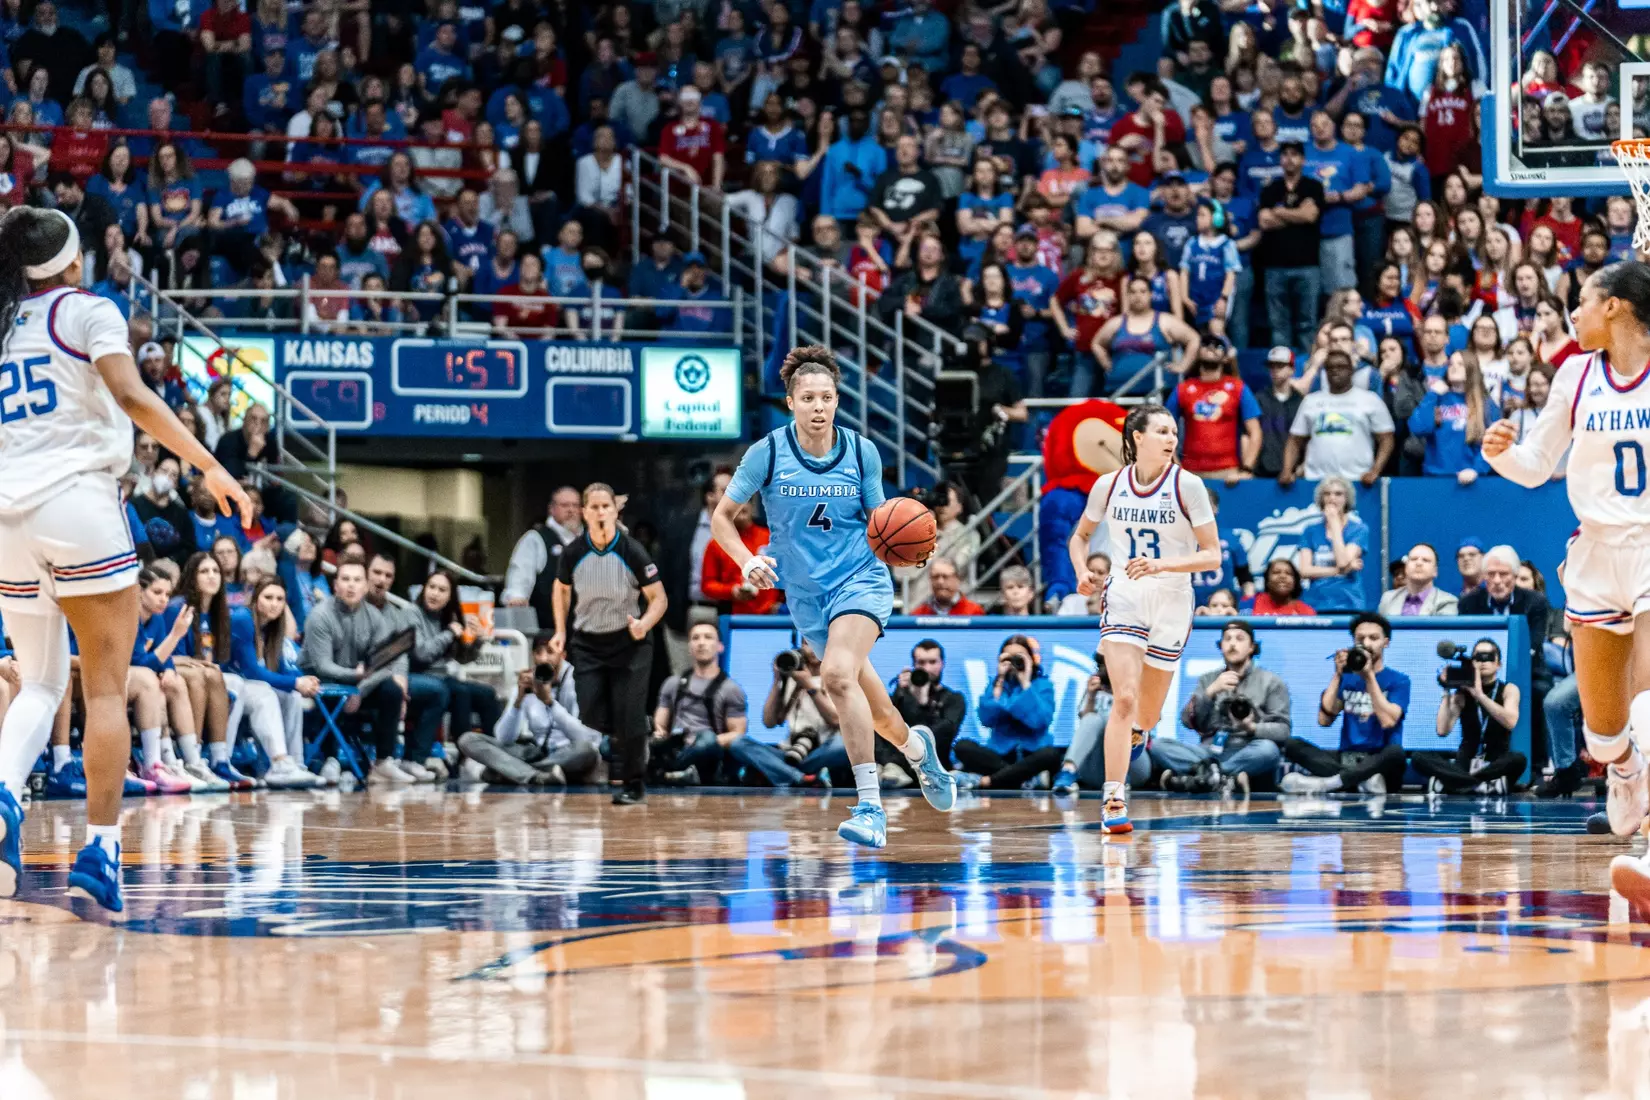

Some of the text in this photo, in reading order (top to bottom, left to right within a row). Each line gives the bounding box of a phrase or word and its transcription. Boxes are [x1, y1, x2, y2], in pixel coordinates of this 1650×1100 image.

[284, 340, 374, 369] KANSAS
[545, 346, 634, 373] COLUMBIA
[445, 349, 515, 390] 1:57
[0, 354, 58, 424] 25
[413, 403, 489, 425] PERIOD 4
[664, 400, 721, 415] Capital
[1586, 408, 1650, 431] AYHAW
[664, 418, 722, 432] Federal
[1613, 440, 1647, 497] 0
[780, 484, 857, 497] COLUMBIA
[807, 502, 833, 532] 4
[1112, 506, 1176, 524] JAYHAWKS
[1125, 527, 1161, 560] 13
